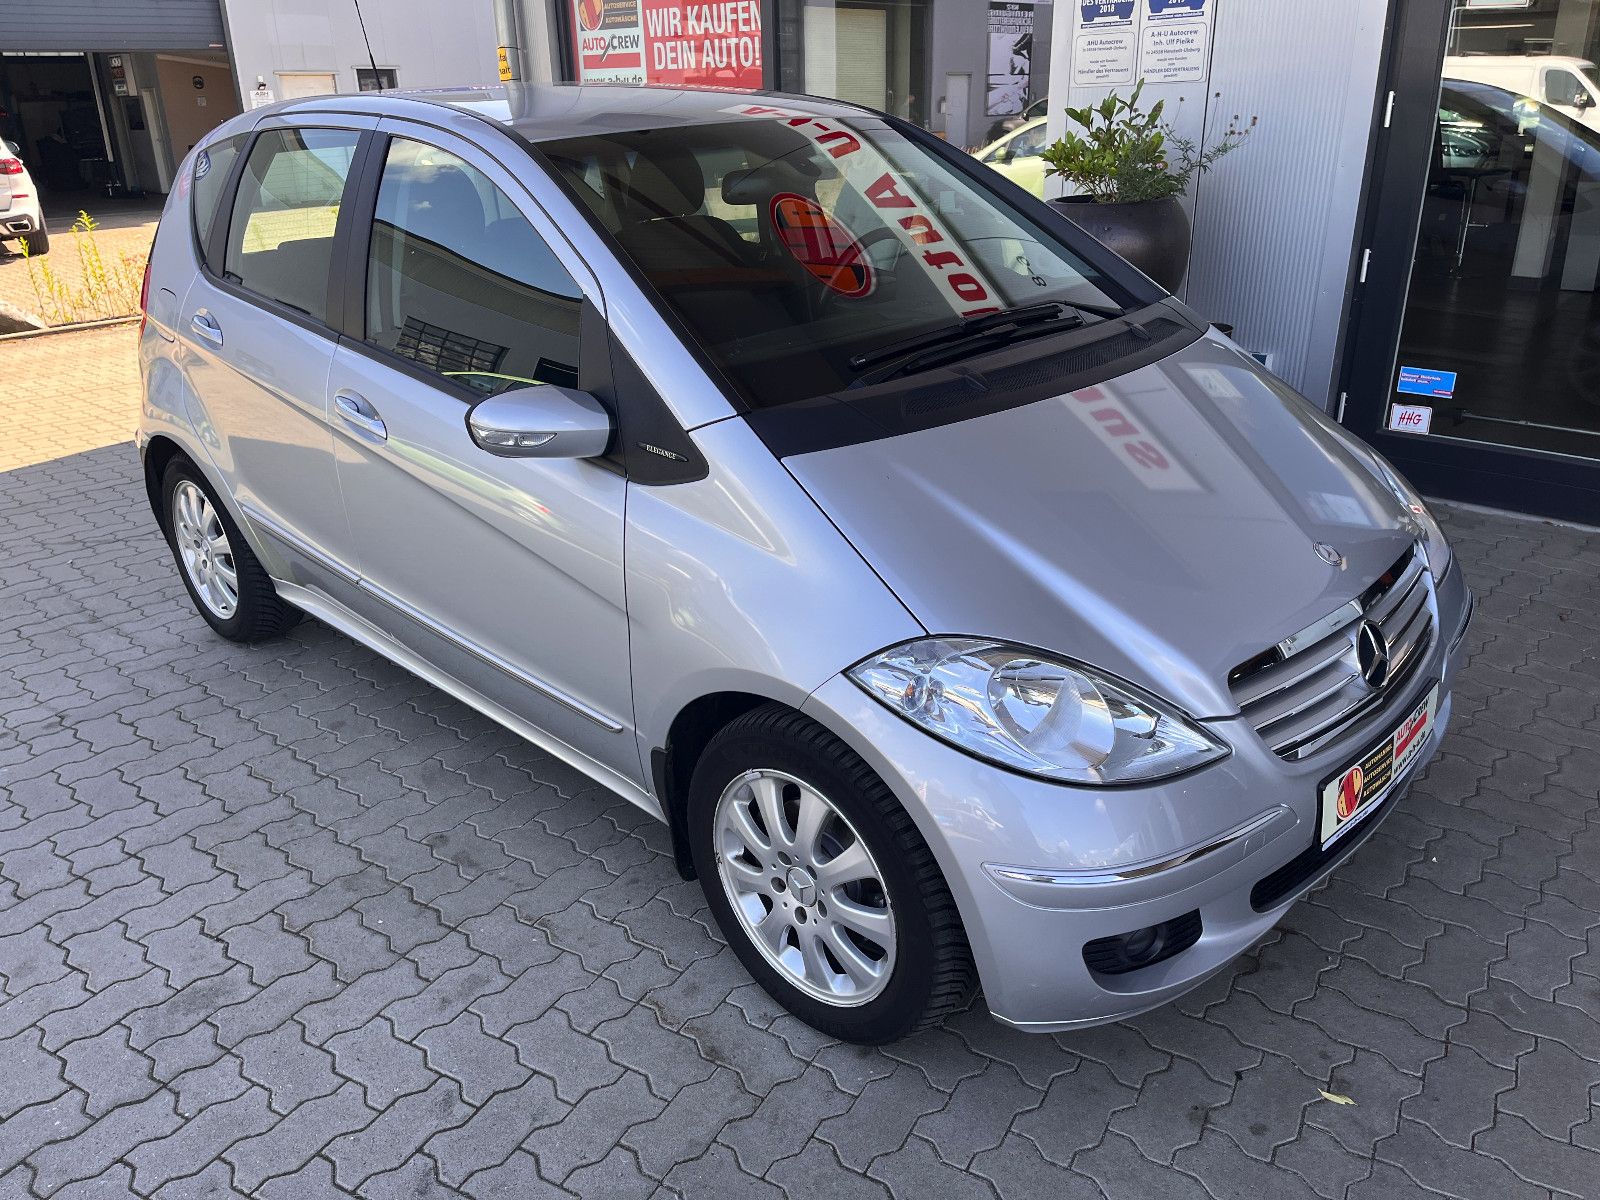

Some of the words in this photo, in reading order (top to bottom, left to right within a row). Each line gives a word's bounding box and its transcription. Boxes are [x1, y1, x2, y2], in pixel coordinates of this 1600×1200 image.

[1100, 4, 1115, 13] 2018
[646, 7, 683, 38] WIR
[687, 1, 762, 35] KAUFEN
[1169, 29, 1199, 37] Autocrew
[582, 36, 607, 51] AUTO
[610, 34, 640, 50] CREW
[653, 40, 697, 70] DEIN
[701, 36, 761, 69] AUTO!
[1398, 410, 1423, 426] HHG
[646, 444, 677, 460] ELEGANCE
